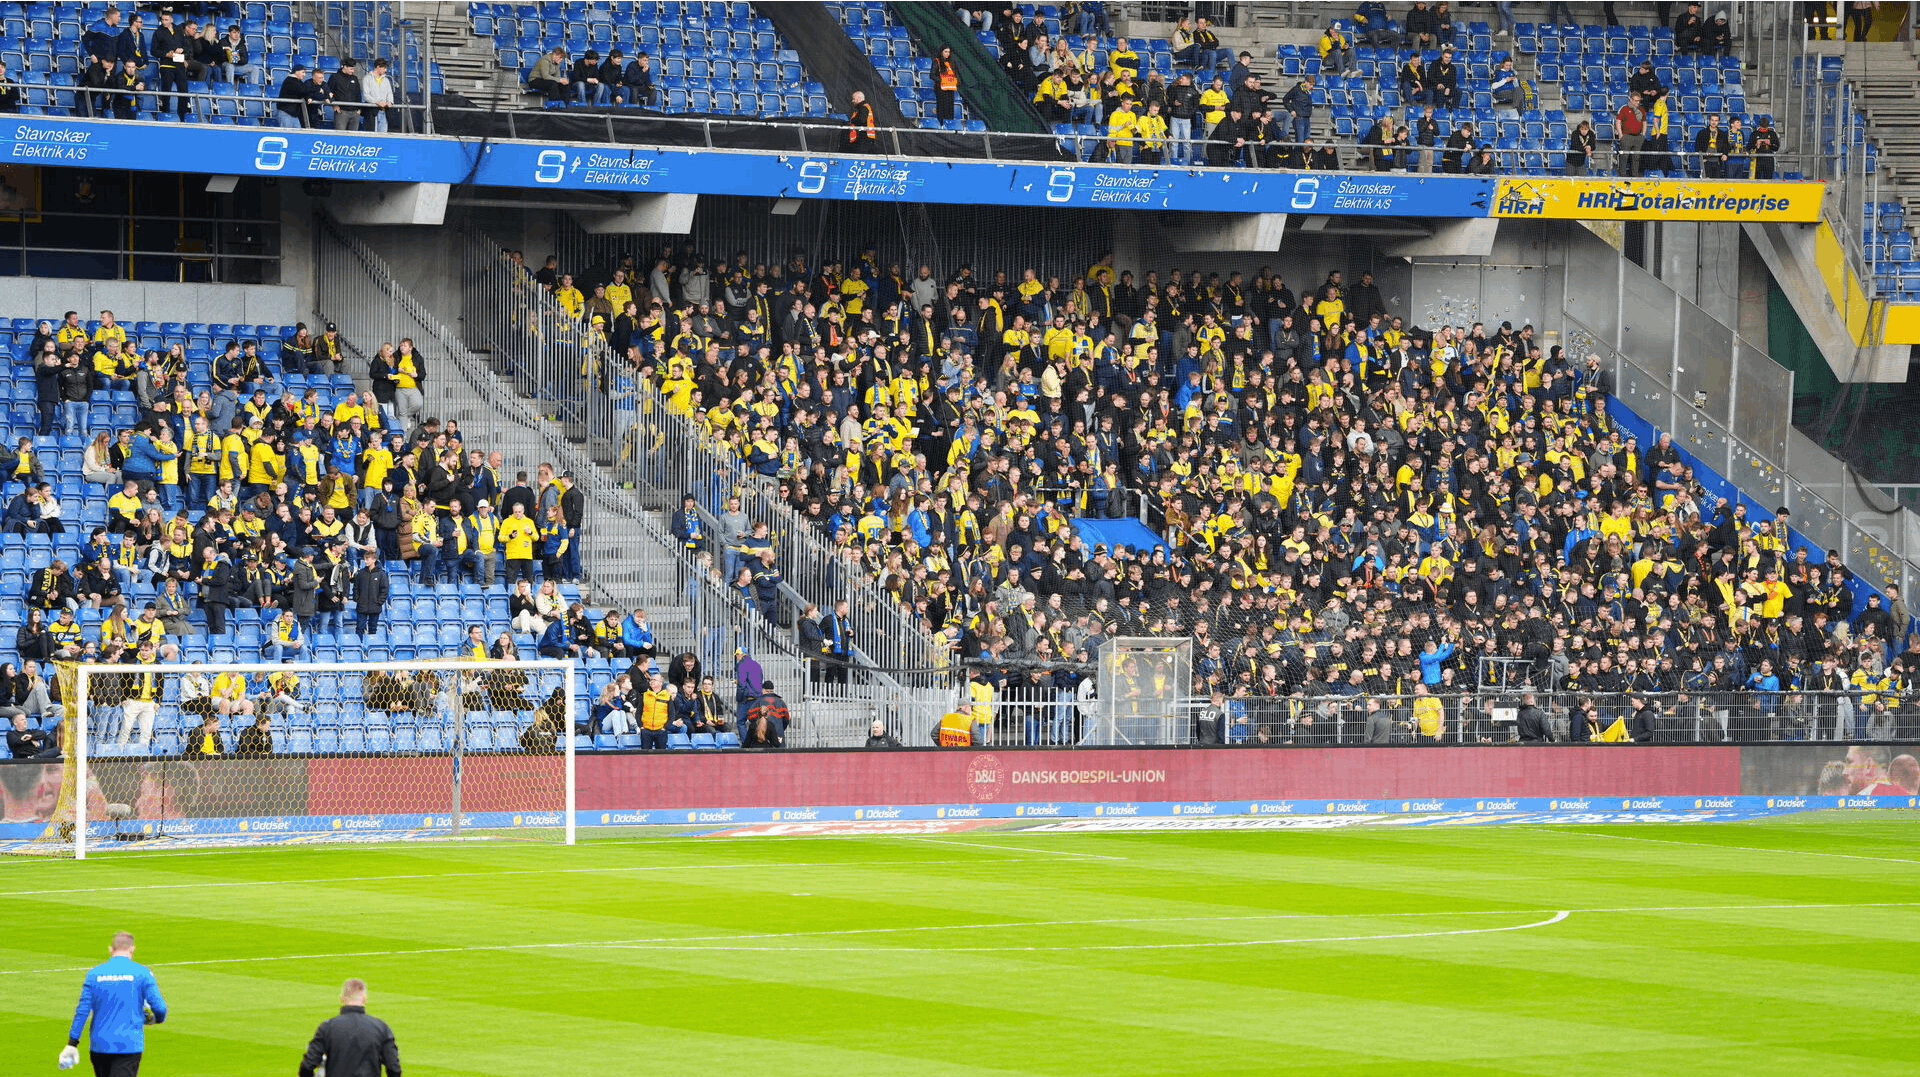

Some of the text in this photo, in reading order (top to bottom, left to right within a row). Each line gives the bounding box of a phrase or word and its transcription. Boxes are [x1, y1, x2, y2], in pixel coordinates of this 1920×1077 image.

[14, 125, 91, 143] Stavnskær
[12, 143, 88, 160] Elektrik A/S
[310, 140, 383, 157] Stavnskær
[308, 157, 379, 174] Elektrik A/S
[587, 153, 654, 170] Stavnskær
[584, 170, 651, 186] Elektrik A/S
[1094, 173, 1155, 188] Stavnskær
[887, 184, 907, 196] A/S
[1337, 180, 1397, 195] Stavnskær
[1091, 189, 1151, 204] Elektrik A/S
[1577, 191, 1624, 209] HRH
[1333, 196, 1392, 210] Elektrik A/S
[1497, 200, 1544, 215] HRH
[1199, 710, 1216, 720] SLO
[974, 769, 996, 783] DBU
[1012, 770, 1058, 784] DANSK
[1337, 803, 1368, 812] Oddset
[1412, 802, 1443, 811] Oddset
[1486, 801, 1517, 810] Oddset
[1559, 800, 1590, 809] Oddset
[1632, 800, 1662, 809] Oddset
[1704, 799, 1734, 808] Oddset
[1776, 799, 1806, 808] Oddset
[1847, 799, 1877, 807] Oddset
[866, 809, 900, 818] Oddset
[948, 808, 980, 817] Oddset
[1027, 806, 1059, 815] Oddset
[1106, 805, 1138, 815] Oddset
[1183, 805, 1215, 814] Oddset
[1261, 804, 1292, 813] Oddset
[525, 815, 561, 824] Oddset
[613, 813, 647, 823] Oddset
[699, 812, 734, 821] Oddset
[783, 810, 817, 820] Oddset
[252, 821, 289, 830] Oddset
[345, 819, 382, 828] Oddset
[436, 817, 472, 827] Odset
